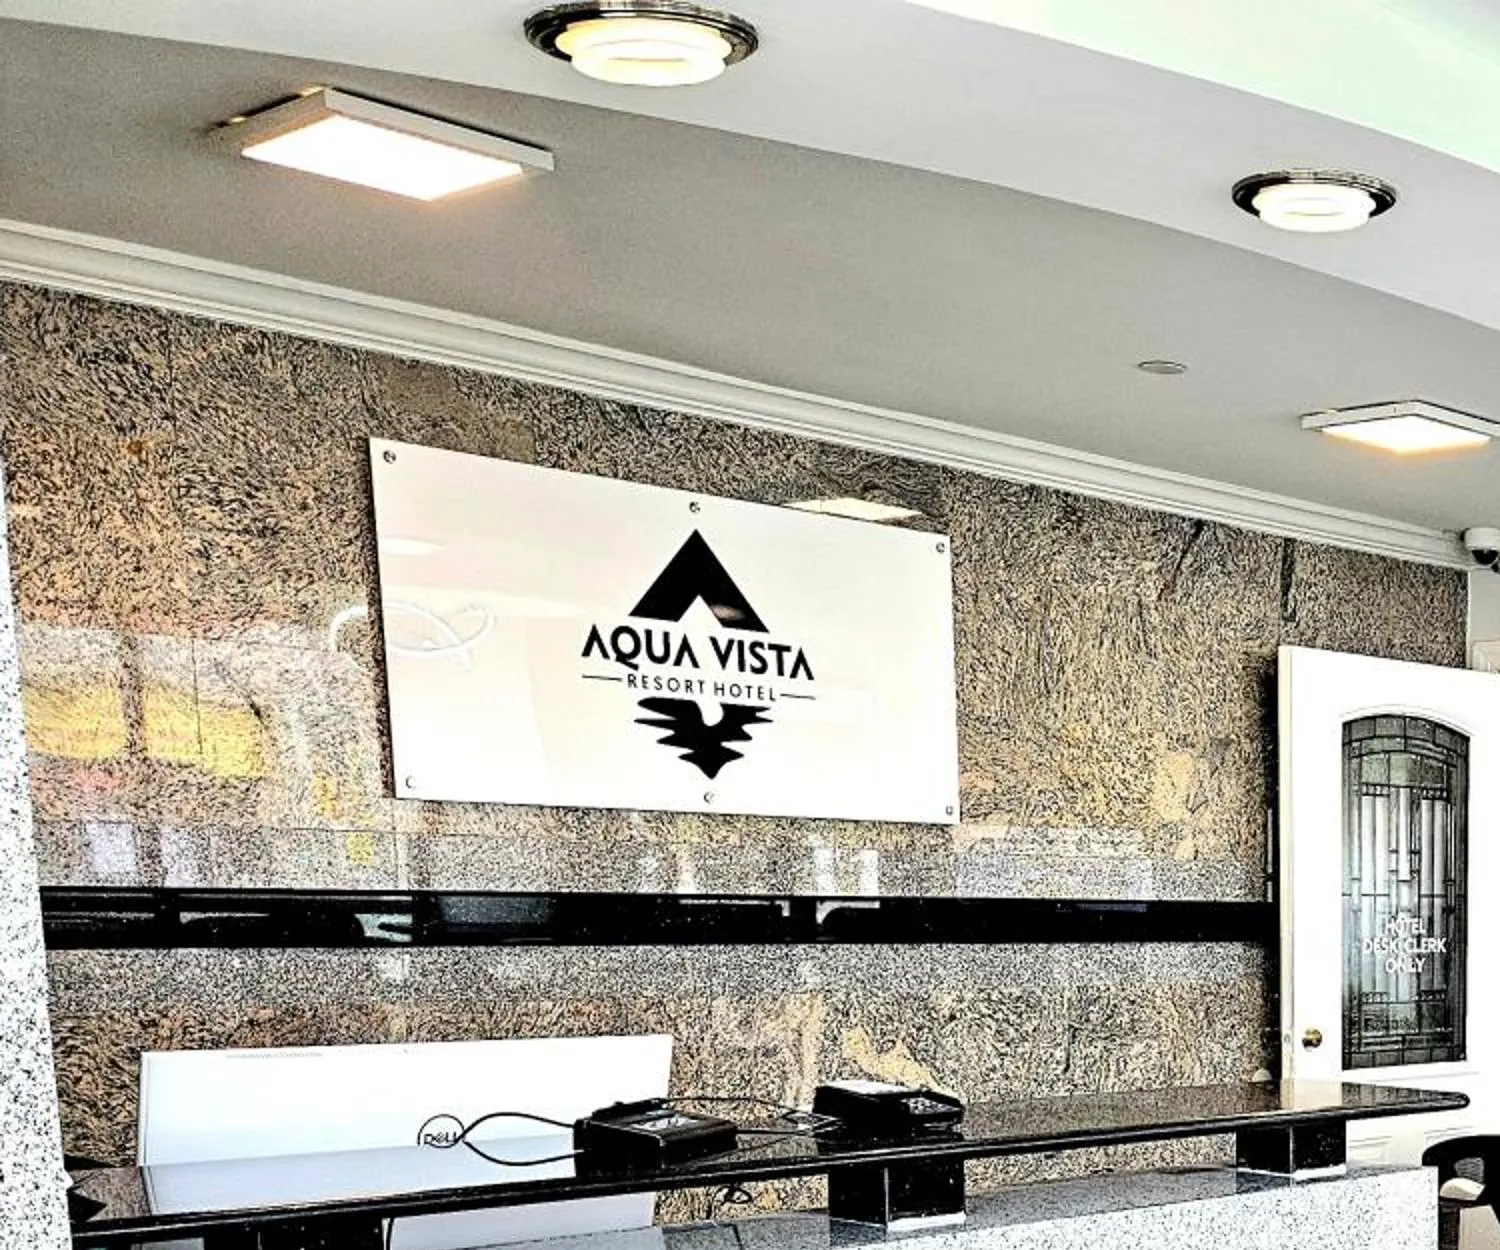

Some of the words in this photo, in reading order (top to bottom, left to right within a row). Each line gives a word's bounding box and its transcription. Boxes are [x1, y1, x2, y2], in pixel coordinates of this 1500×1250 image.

[581, 624, 700, 672] AQUA
[708, 635, 815, 681] VISTA
[627, 673, 705, 695] RESORT
[713, 681, 776, 701] HOTEL
[1385, 917, 1427, 935] HOTEL
[1363, 937, 1400, 954] DESK
[1404, 937, 1447, 953] CLERK
[1385, 957, 1426, 974] ONLY
